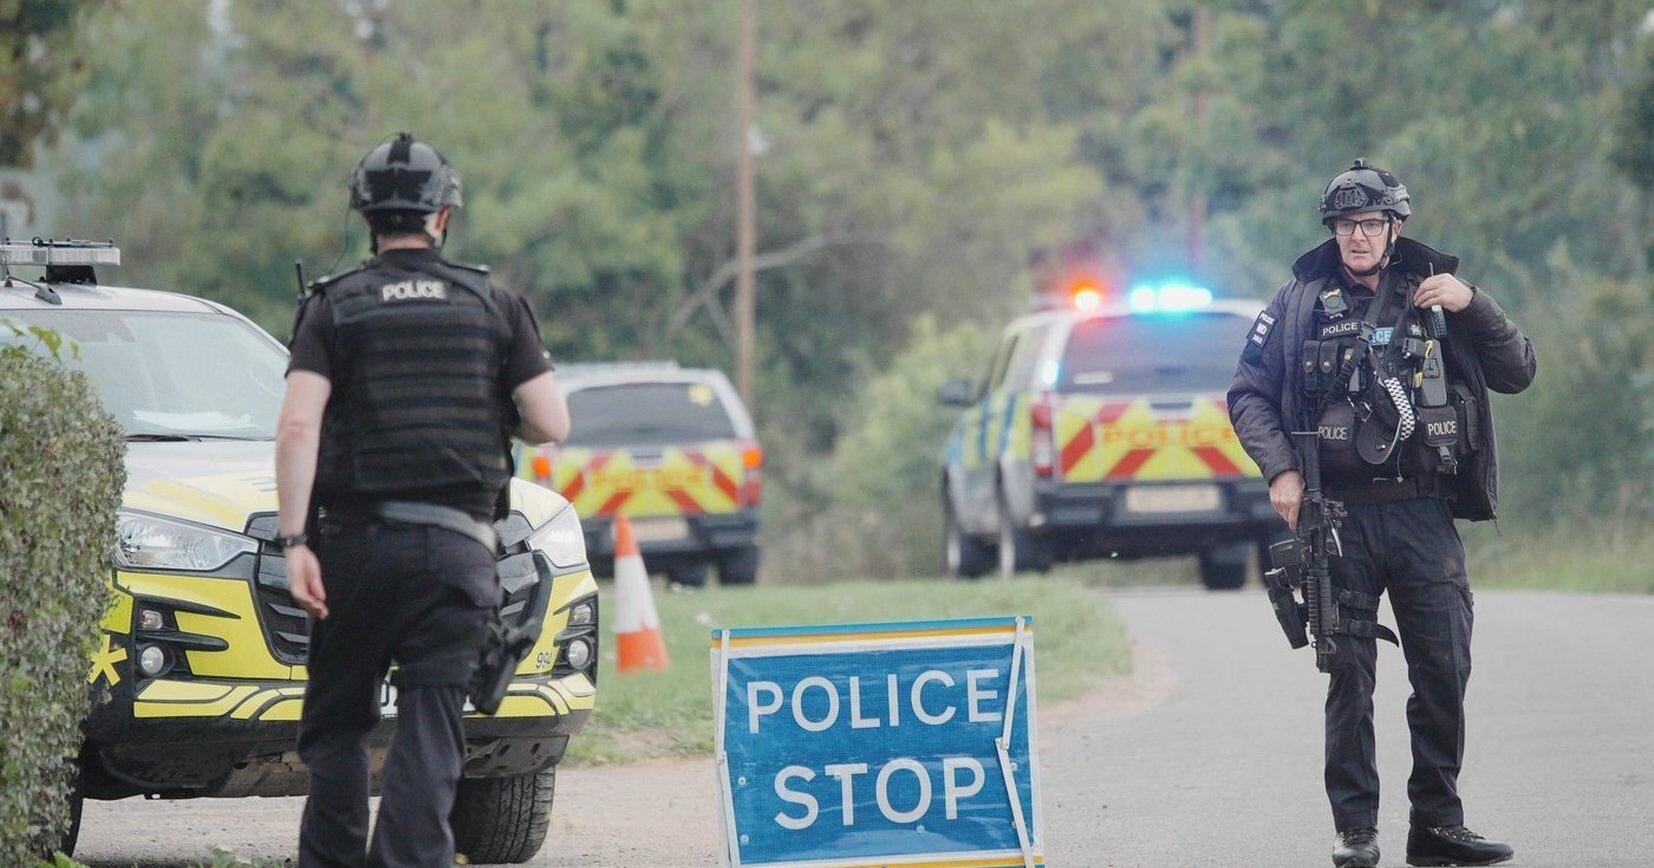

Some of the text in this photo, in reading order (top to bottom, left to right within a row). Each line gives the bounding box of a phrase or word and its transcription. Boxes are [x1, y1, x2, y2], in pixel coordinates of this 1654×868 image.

[382, 280, 446, 301] POLICE
[1322, 322, 1357, 336] POLICE
[1318, 425, 1348, 440] POLICE
[1427, 421, 1457, 436] POLICE
[747, 668, 1003, 734] POLICE
[774, 757, 985, 830] STOP
